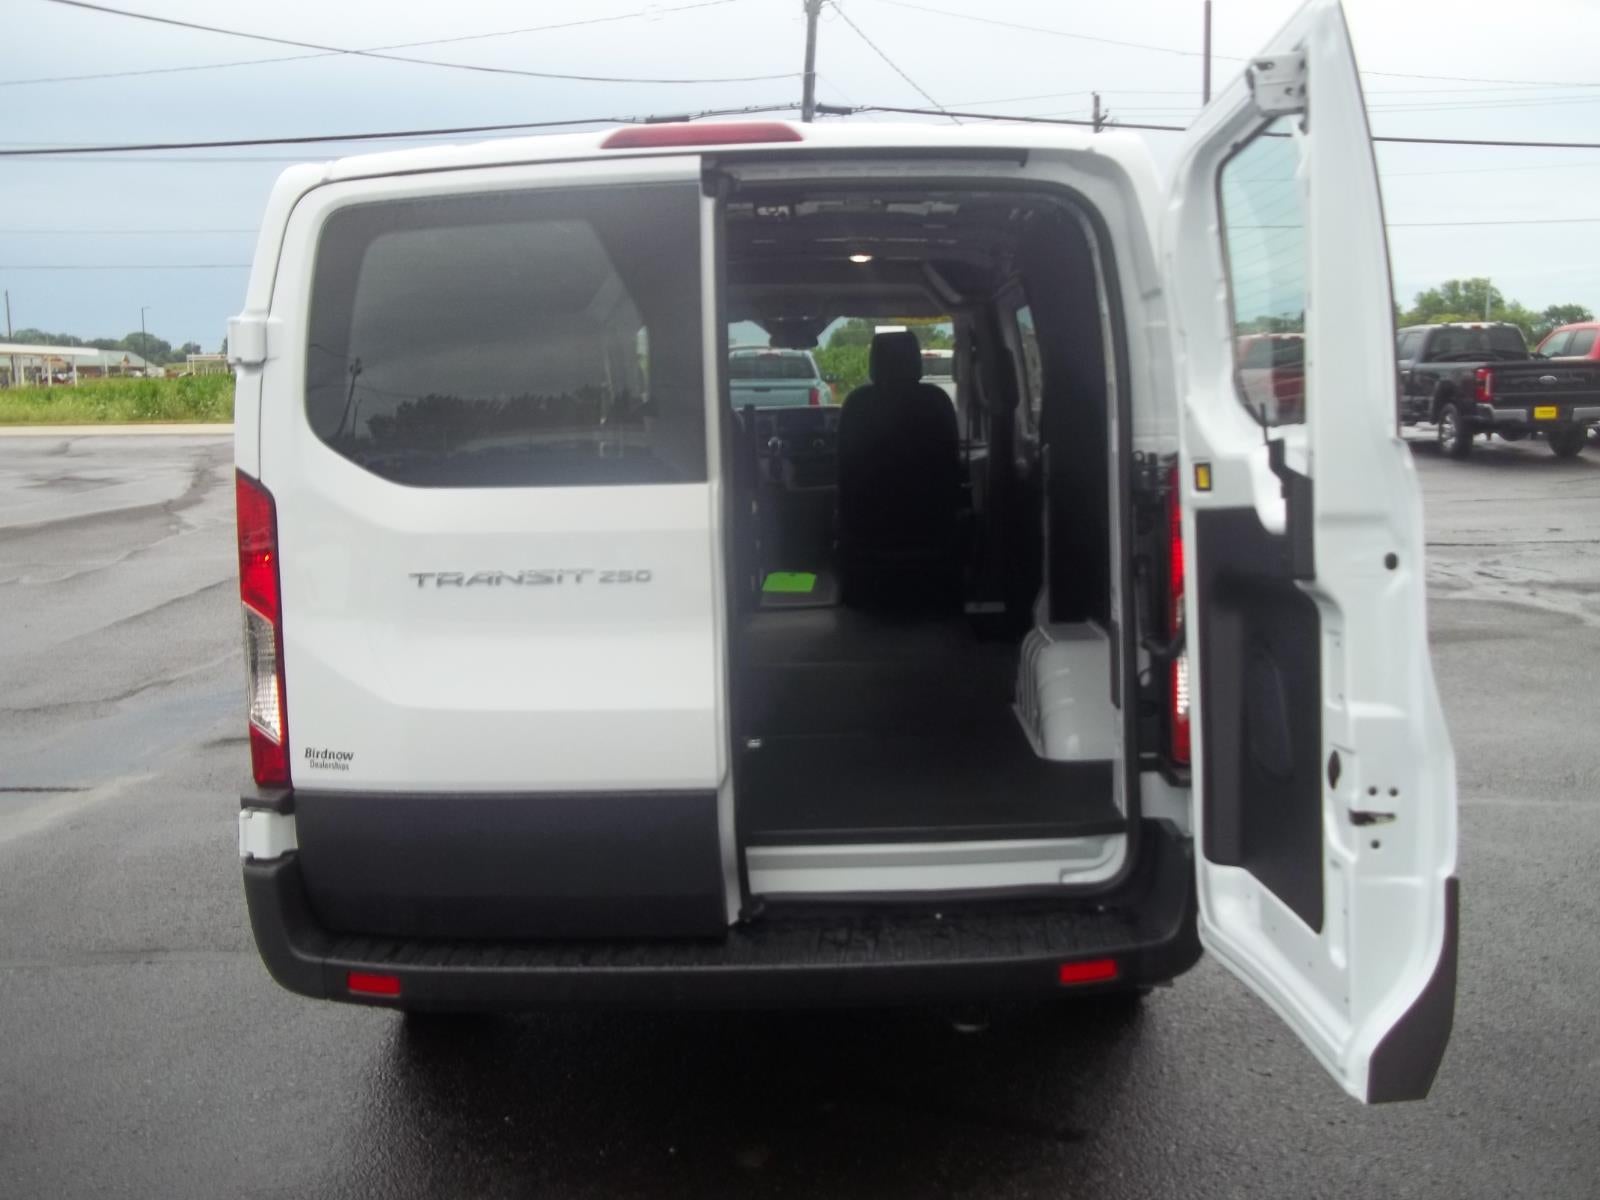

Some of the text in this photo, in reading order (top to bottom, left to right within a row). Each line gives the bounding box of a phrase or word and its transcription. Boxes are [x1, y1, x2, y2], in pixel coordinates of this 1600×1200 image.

[408, 569, 652, 588] TRANSIT 250
[304, 747, 354, 761] Birdnow
